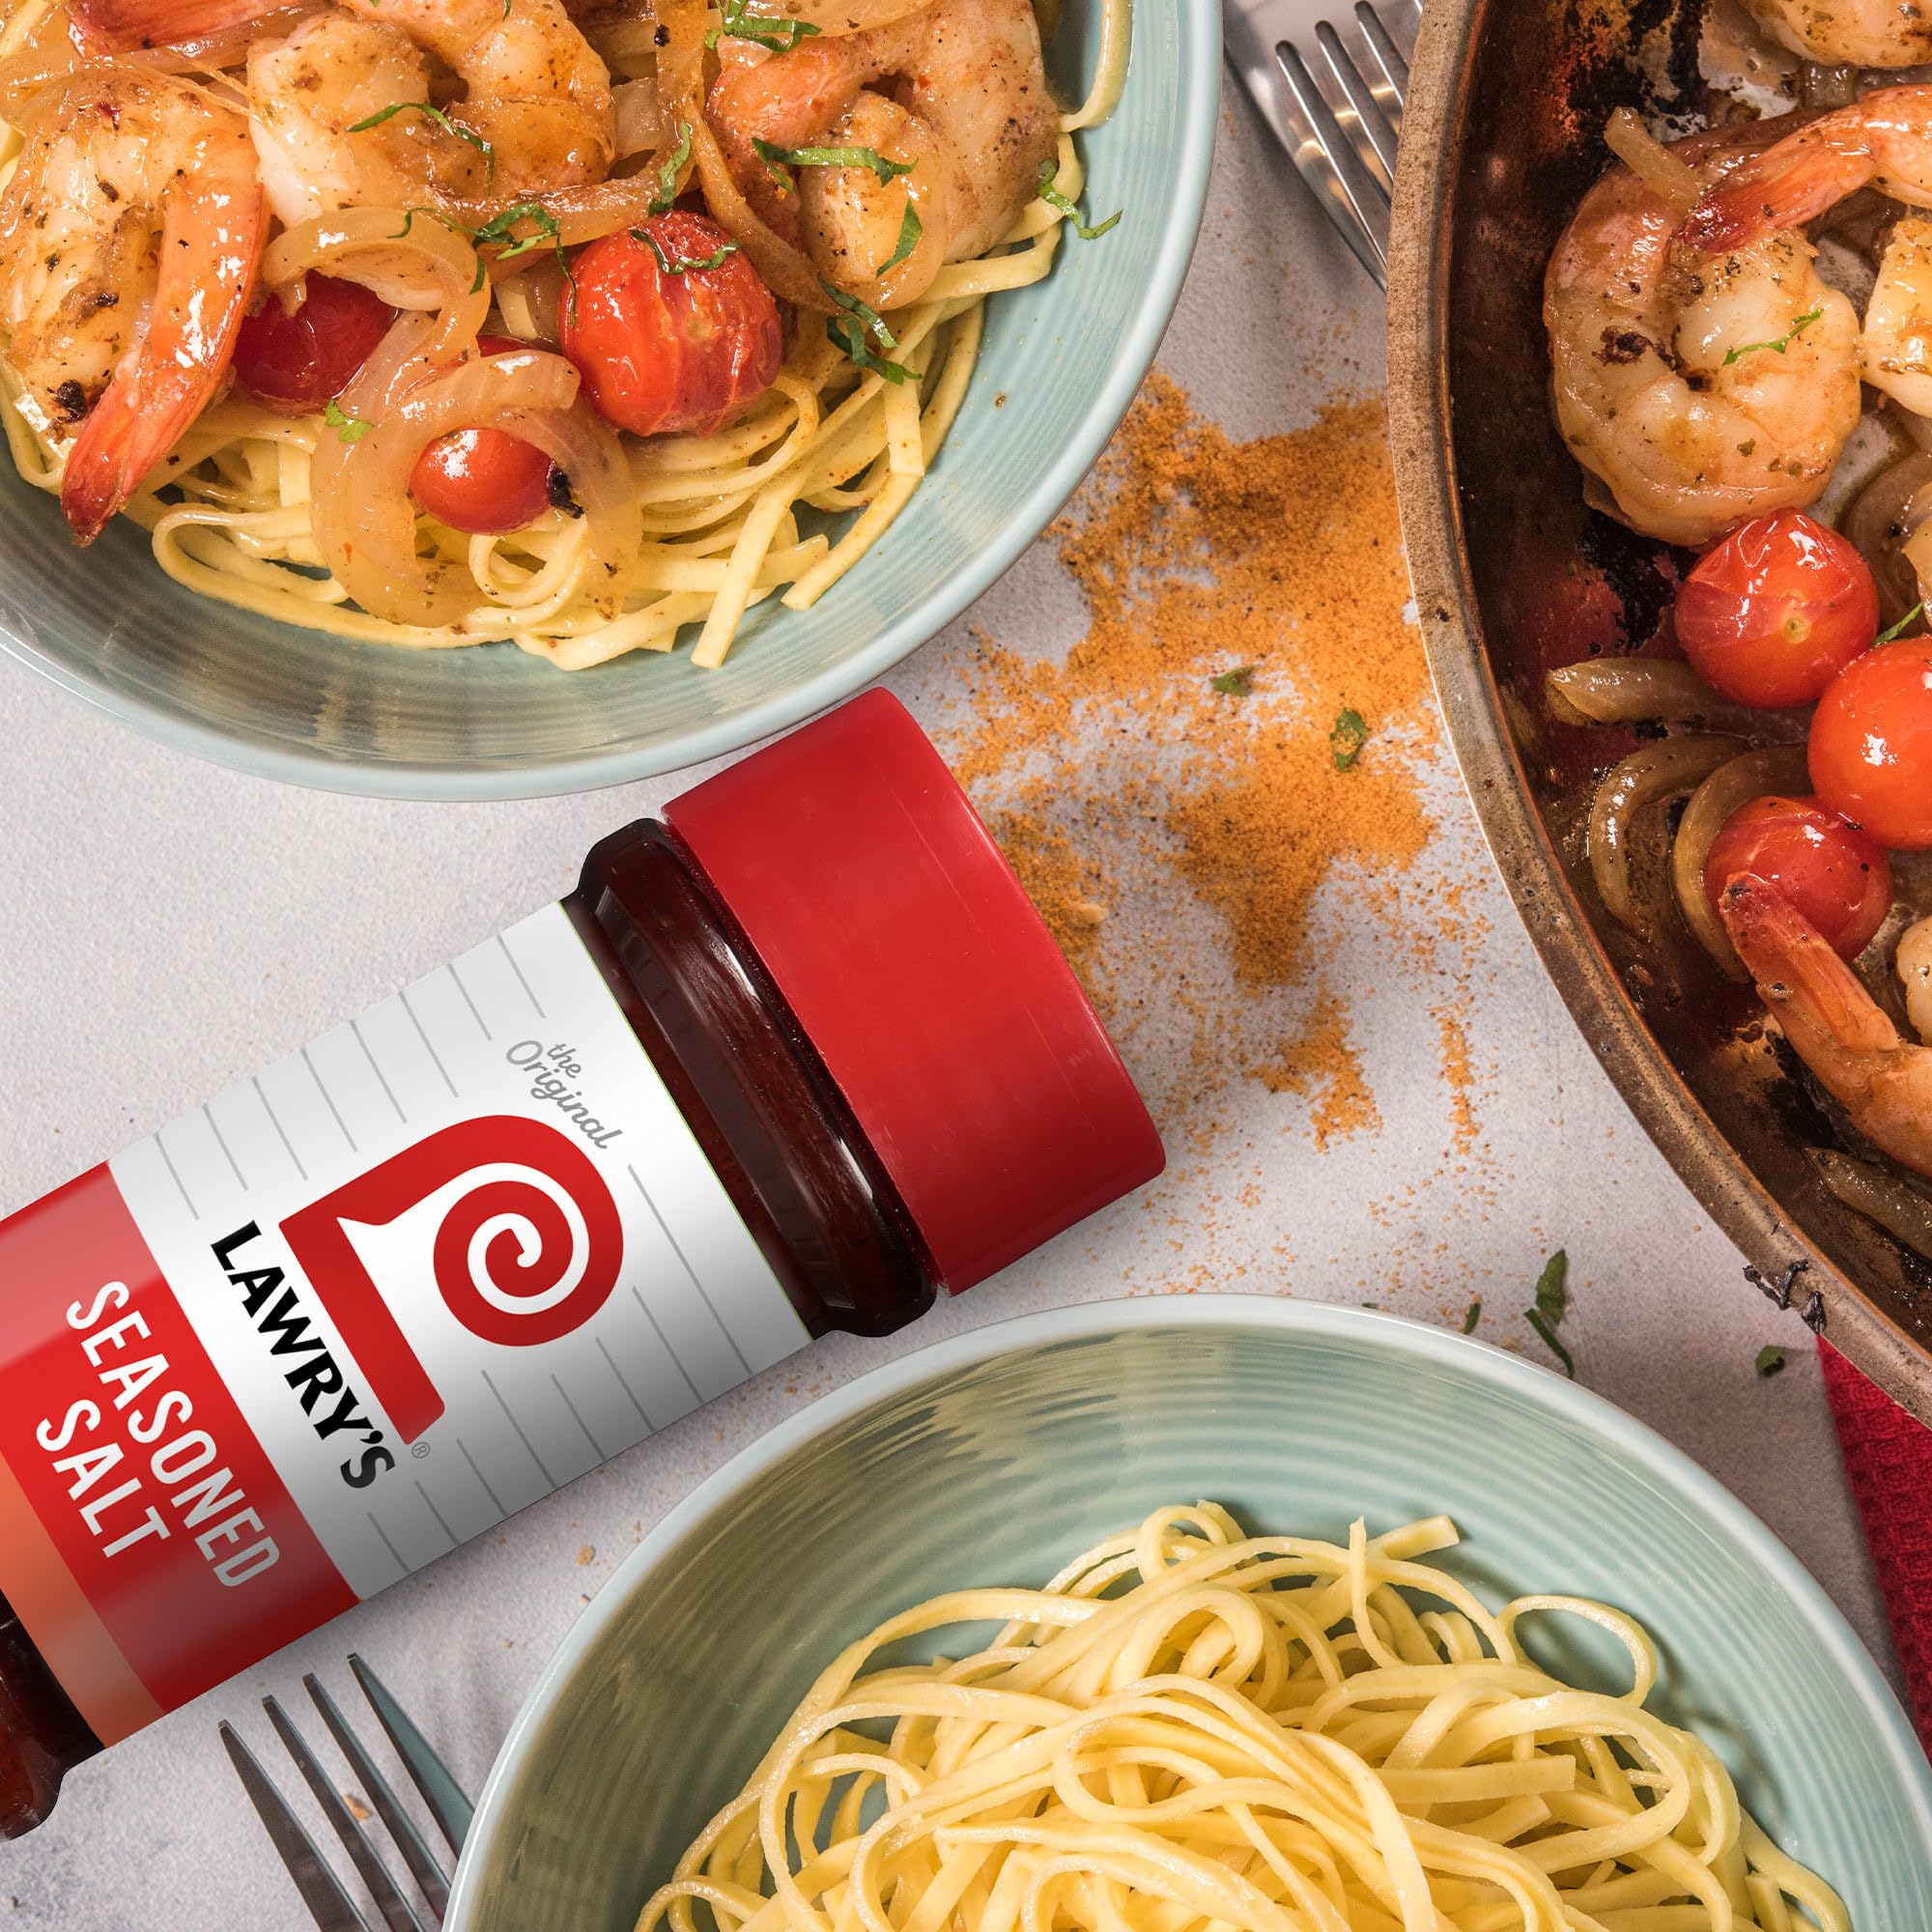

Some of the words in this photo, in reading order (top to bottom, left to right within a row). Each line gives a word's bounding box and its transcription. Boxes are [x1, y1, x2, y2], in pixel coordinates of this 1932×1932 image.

[505, 1039, 623, 1150] Original
[546, 1042, 582, 1079] the
[66, 1281, 280, 1587] SEASONED
[210, 1220, 396, 1489] LAWRY'S
[35, 1399, 171, 1558] SALT
